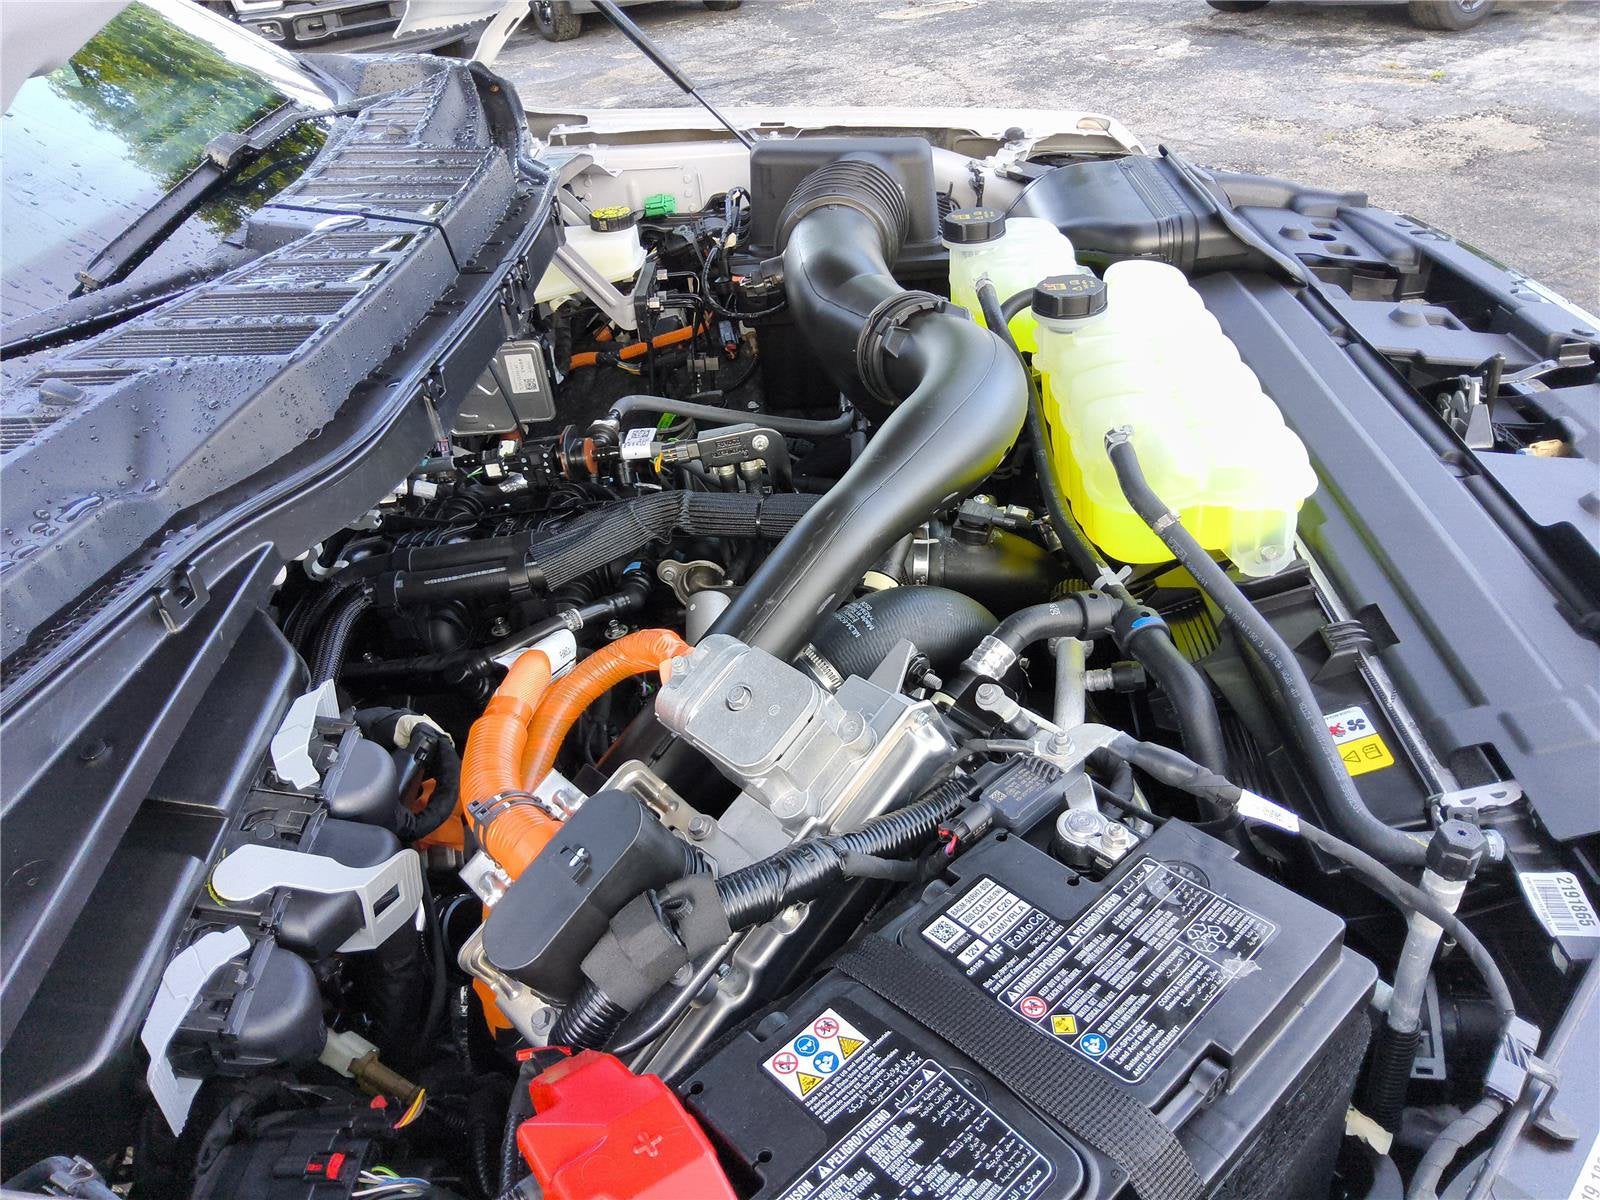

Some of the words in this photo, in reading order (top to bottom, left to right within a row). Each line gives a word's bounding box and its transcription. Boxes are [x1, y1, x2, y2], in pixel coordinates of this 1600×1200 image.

[961, 912, 975, 923] 800
[971, 903, 985, 915] CCA
[976, 919, 989, 929] 80
[985, 910, 999, 921] Ah
[995, 898, 1012, 912] C20
[1556, 877, 1596, 926] 2191865
[986, 904, 1026, 938] AGM/VRLA
[1004, 912, 1045, 946] FoMoCo
[964, 944, 981, 958] 12V
[983, 943, 1007, 962] MF
[1012, 945, 1067, 993] DANGER/POISON
[1072, 892, 1123, 937] PELIGRO/VENENO
[988, 982, 1002, 993] Ford
[998, 971, 1014, 984] Motor
[1036, 985, 1051, 996] KEEP
[1141, 977, 1153, 987] LEA
[1157, 985, 1180, 1007] CONTRA
[1176, 959, 1203, 986] DERRAMES
[1097, 1020, 1112, 1033] READ
[1104, 1026, 1118, 1038] LIRE
[1107, 1018, 1148, 1060] NON-SPILLABLE
[1114, 1050, 1130, 1064] Lead
[1126, 1039, 1140, 1052] Acid
[1136, 1022, 1158, 1042] Battery
[1123, 1050, 1144, 1070] Batterie
[1141, 1043, 1151, 1052] au
[1146, 1028, 1166, 1046] plomb
[1132, 1061, 1148, 1076] ANTI
[1141, 1023, 1181, 1064] DÉVERSEMENT
[804, 1095, 819, 1107] Made
[820, 1082, 832, 1093] USA
[830, 1074, 841, 1085] with
[839, 1068, 848, 1077] US
[845, 1061, 856, 1071] and
[853, 1045, 874, 1064] imported
[871, 1028, 893, 1048] materials.
[876, 1048, 899, 1068] materiales
[827, 1086, 838, 1095] aux
[865, 1051, 876, 1061] des
[860, 1066, 887, 1091] importados.
[824, 1108, 893, 1169] PELIGRO/VENENO
[863, 1132, 891, 1157] PROTEJA
[886, 1123, 901, 1137] LOS
[869, 1144, 890, 1163] OJOS.
[885, 1135, 900, 1149] LOS
[895, 1121, 916, 1140] GASES
[876, 1137, 913, 1169] EXPLOSIVOS
[883, 1153, 907, 1175] PUEDEN
[902, 1137, 925, 1158] CAUSAR
[842, 1177, 857, 1190] LES
[852, 1167, 869, 1181] GAZ
[889, 1161, 911, 1180] DAÑOS
[897, 1161, 925, 1186] CEGUERA.
[921, 1163, 945, 1183] CHISPAS
[928, 1169, 951, 1189] FLAMAS
[935, 1171, 962, 1195] CIGARROS
[850, 1172, 877, 1195] PEUVENT
[911, 1184, 923, 1195] NO
[970, 1177, 994, 1199] CEGUERA
